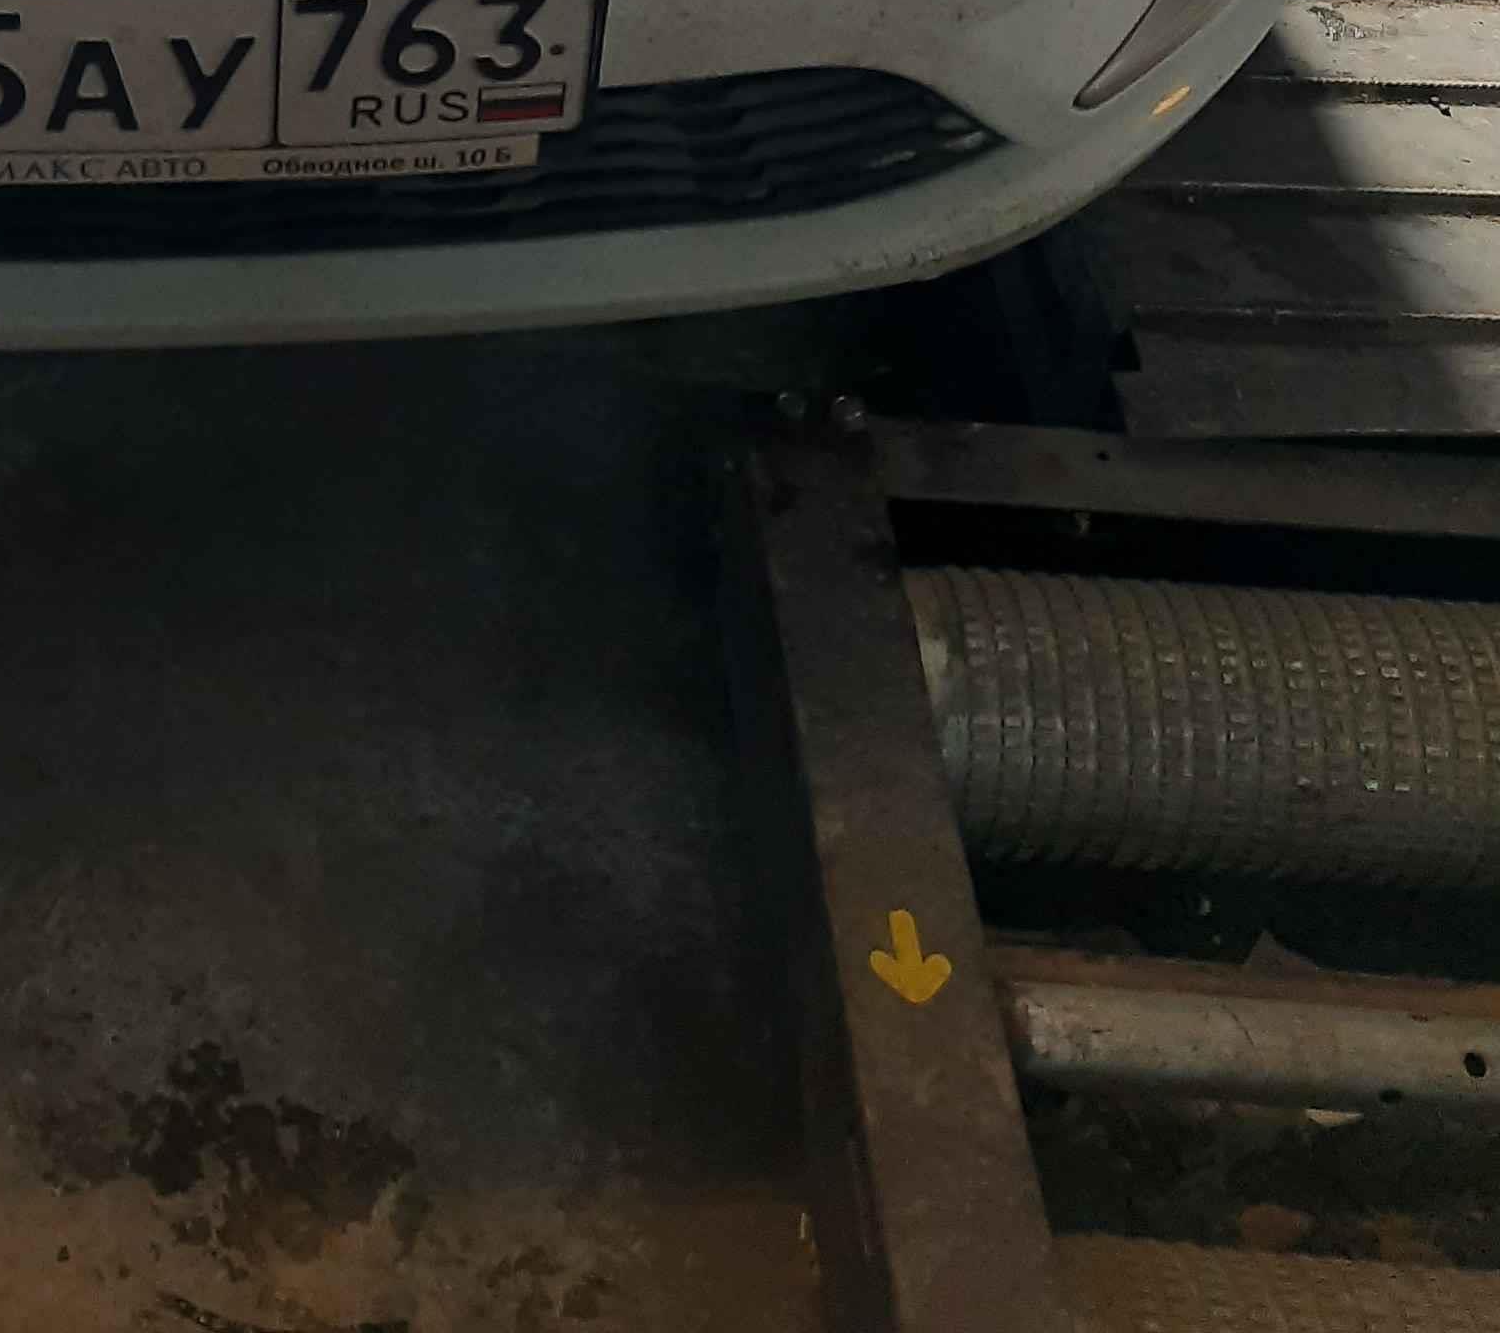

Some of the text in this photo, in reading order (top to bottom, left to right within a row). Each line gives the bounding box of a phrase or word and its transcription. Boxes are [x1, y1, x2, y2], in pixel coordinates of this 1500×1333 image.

[349, 88, 470, 129] RUS
[116, 158, 207, 180] АВТО
[262, 157, 406, 178] Обводное
[456, 148, 487, 167] 10
